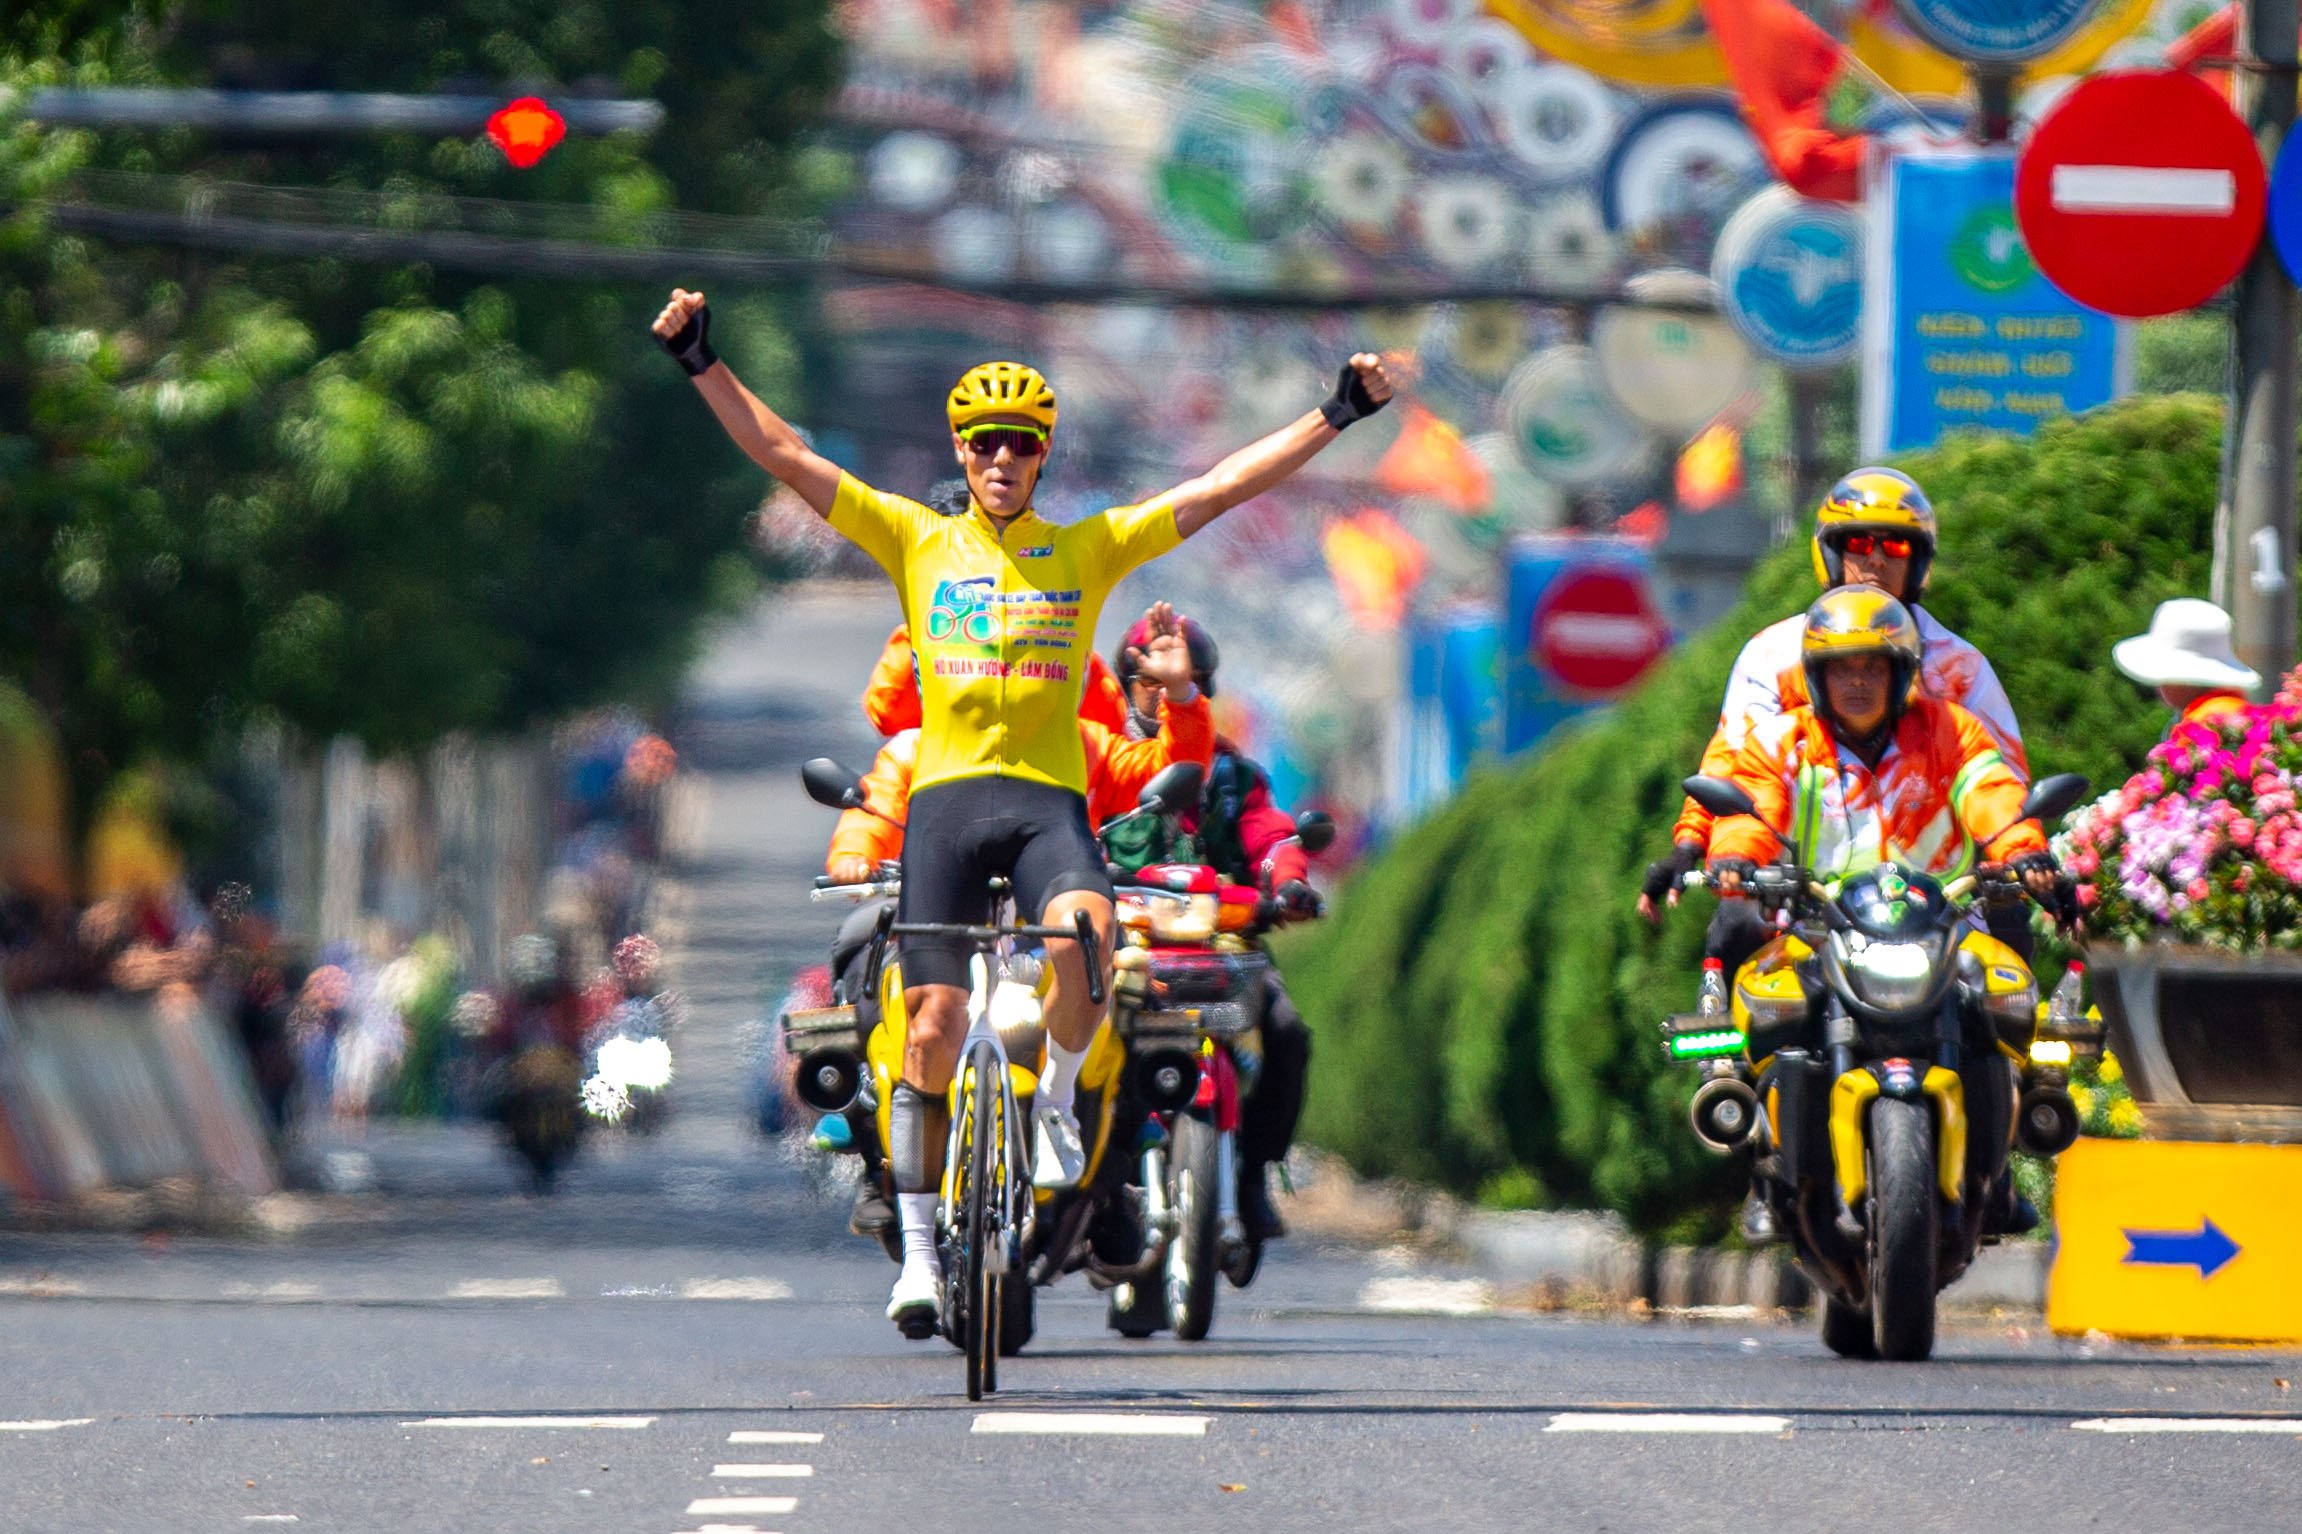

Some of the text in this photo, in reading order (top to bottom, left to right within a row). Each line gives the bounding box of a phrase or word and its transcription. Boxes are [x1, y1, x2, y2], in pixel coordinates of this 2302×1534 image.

[2249, 525, 2287, 593] 1
[948, 657, 973, 675] XUÂN
[1020, 659, 1041, 677] LÂM
[1045, 658, 1069, 681] ĐỒNG
